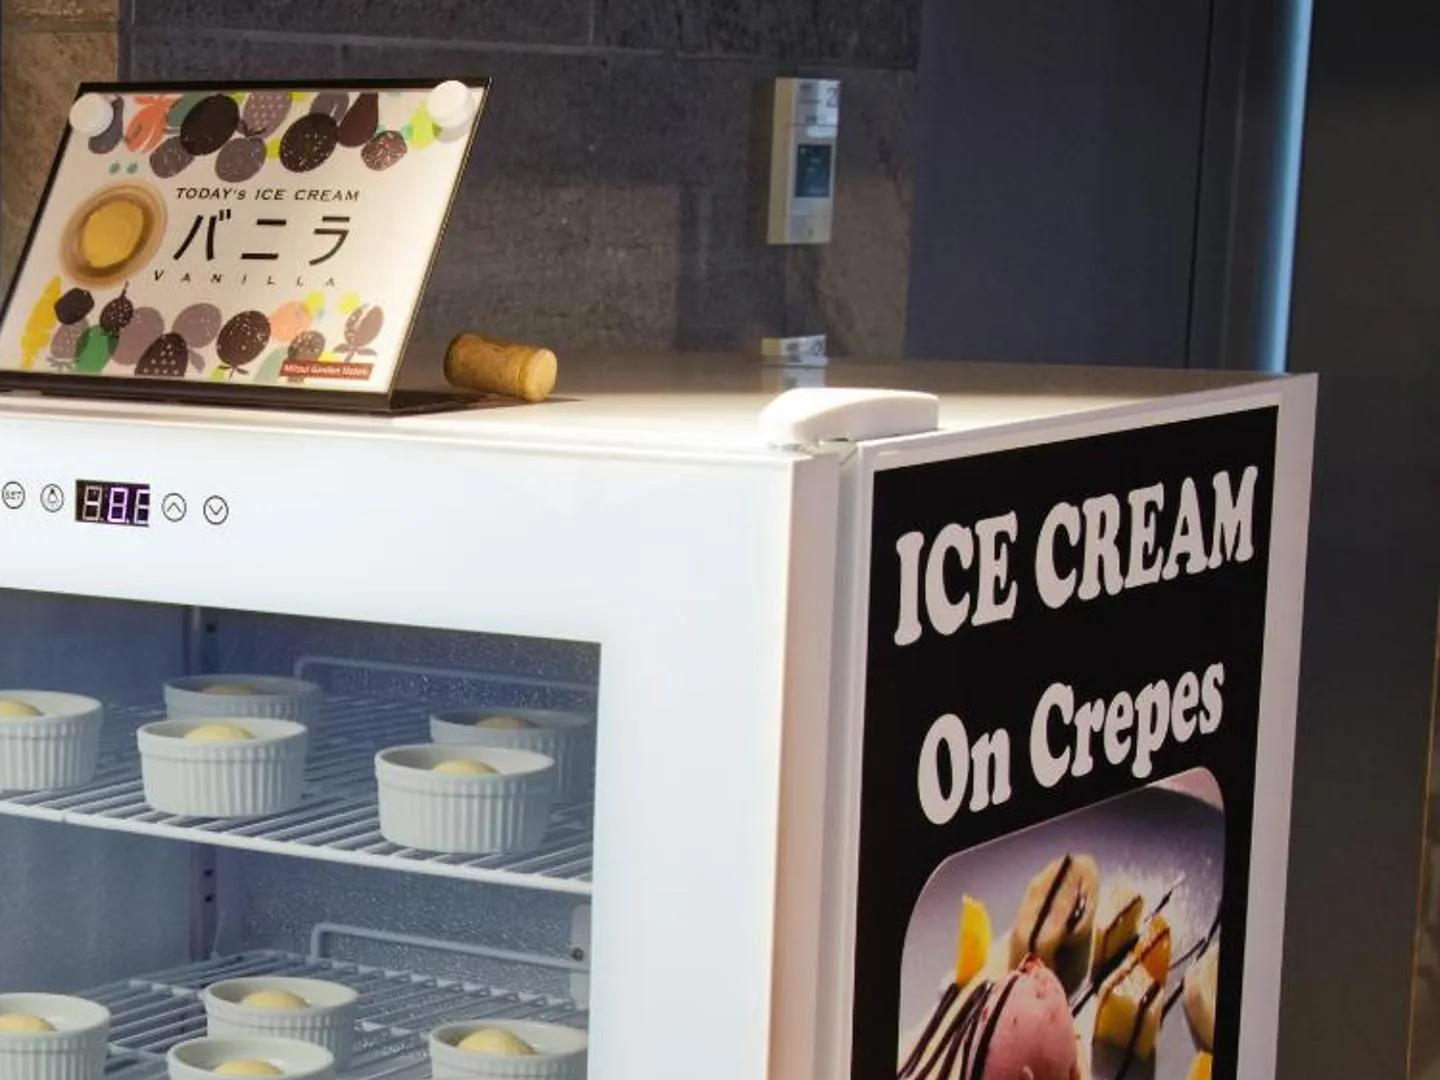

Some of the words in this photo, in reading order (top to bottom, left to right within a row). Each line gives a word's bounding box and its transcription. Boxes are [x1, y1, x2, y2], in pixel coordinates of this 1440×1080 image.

[255, 188, 286, 200] ICE
[294, 189, 360, 201] CREAM
[173, 208, 350, 266] バニラ
[154, 269, 336, 287] VANILLA
[894, 511, 1018, 646] ICE
[1035, 466, 1258, 609] CREAM
[917, 713, 1012, 825] On
[1030, 662, 1225, 788] Crepes
